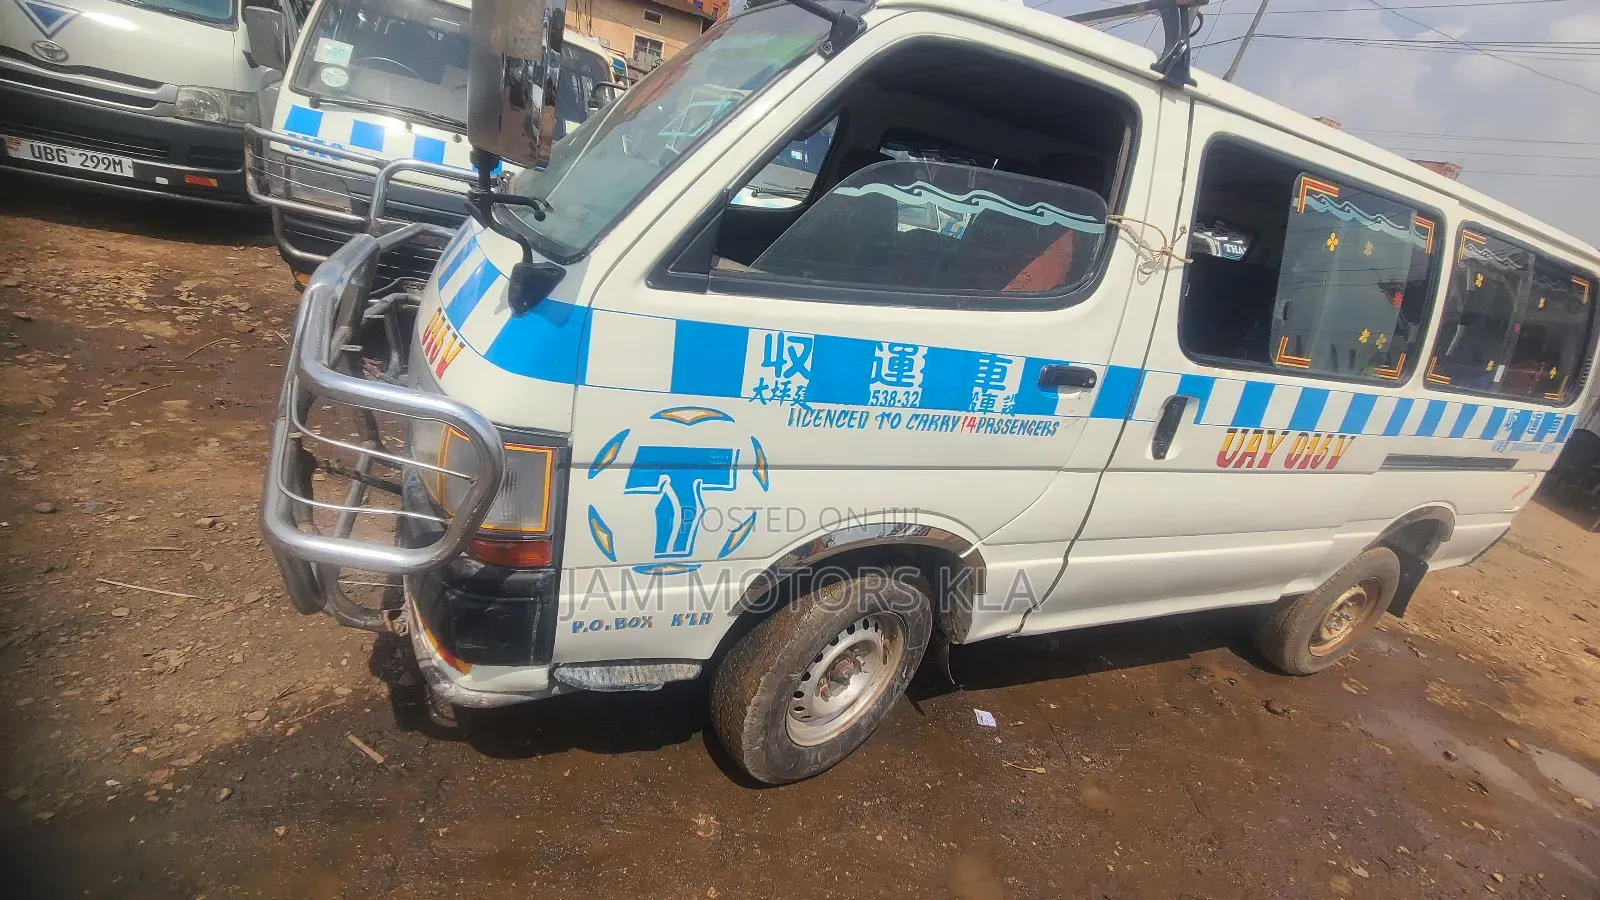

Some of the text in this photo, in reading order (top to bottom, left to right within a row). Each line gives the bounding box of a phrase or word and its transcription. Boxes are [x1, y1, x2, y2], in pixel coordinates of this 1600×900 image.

[29, 143, 125, 174] UBG 299M
[875, 411, 902, 430] TO
[905, 413, 961, 433] CARRY
[960, 415, 977, 434] 14
[974, 416, 1060, 437] PASSENGERS
[1216, 427, 1290, 469] UAY
